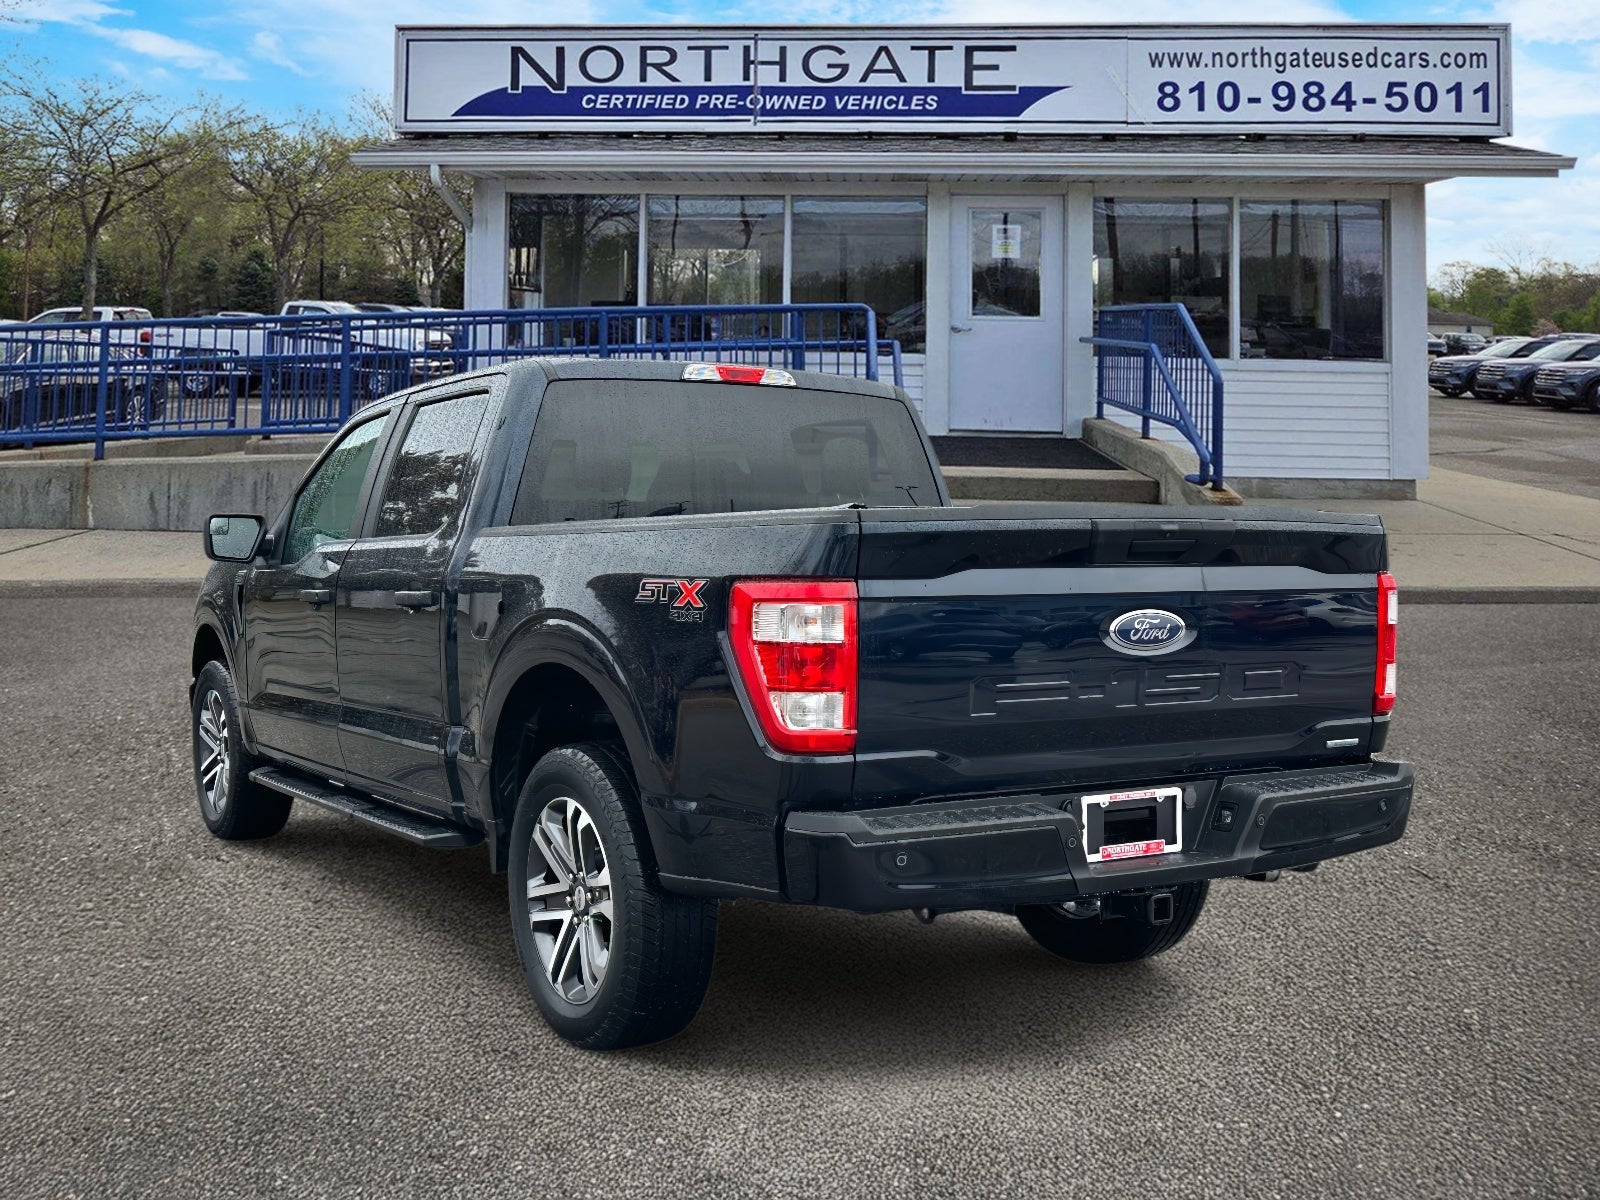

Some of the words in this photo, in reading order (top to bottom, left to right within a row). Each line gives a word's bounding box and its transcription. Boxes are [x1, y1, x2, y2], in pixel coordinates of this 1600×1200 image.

[510, 45, 1017, 92] NORTHGATE
[1148, 46, 1488, 74] www.northgateusedcars.com
[581, 94, 689, 110] CERTIFIED
[695, 94, 827, 110] PRE-OWNED
[834, 95, 939, 111] VEHICLES
[1156, 80, 1491, 114] 810-984-5011
[635, 578, 710, 611] STX
[1129, 618, 1171, 641] Ford
[969, 661, 1304, 717] F-150
[1107, 844, 1147, 855] NORTHGATE
